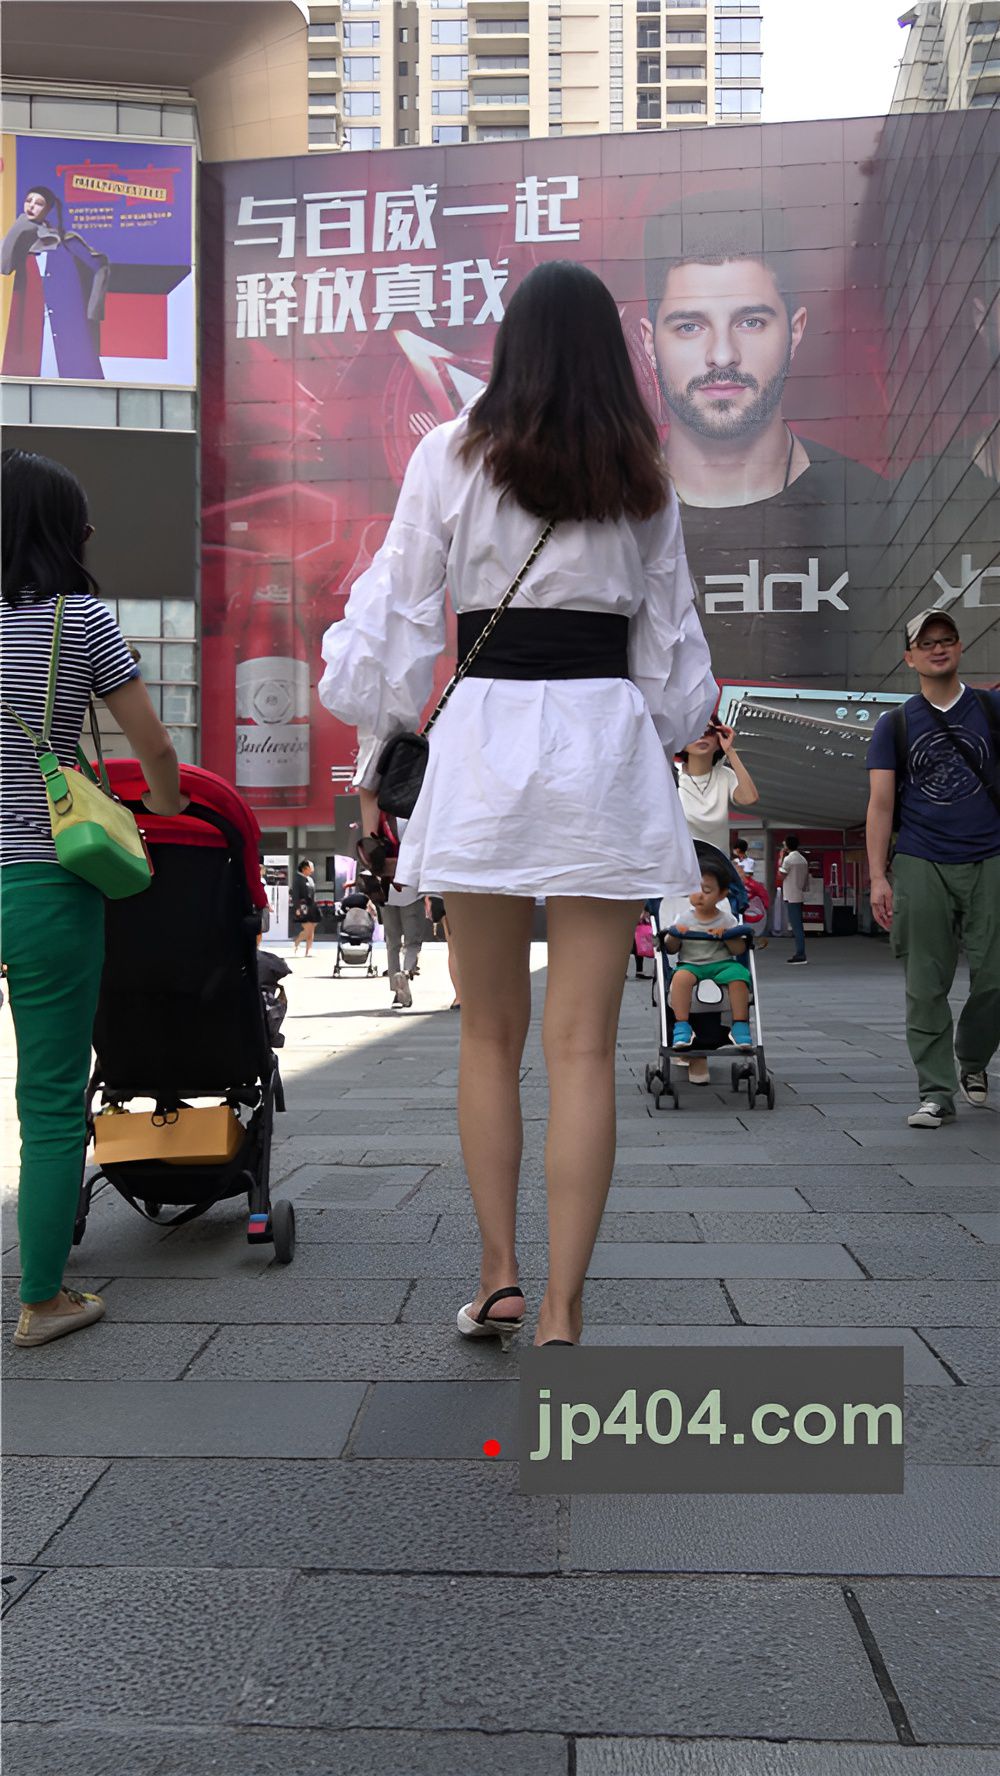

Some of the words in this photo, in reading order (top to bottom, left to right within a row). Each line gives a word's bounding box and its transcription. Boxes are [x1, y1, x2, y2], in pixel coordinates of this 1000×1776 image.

[234, 175, 580, 258] 与百威一起
[236, 258, 509, 338] 释放真我
